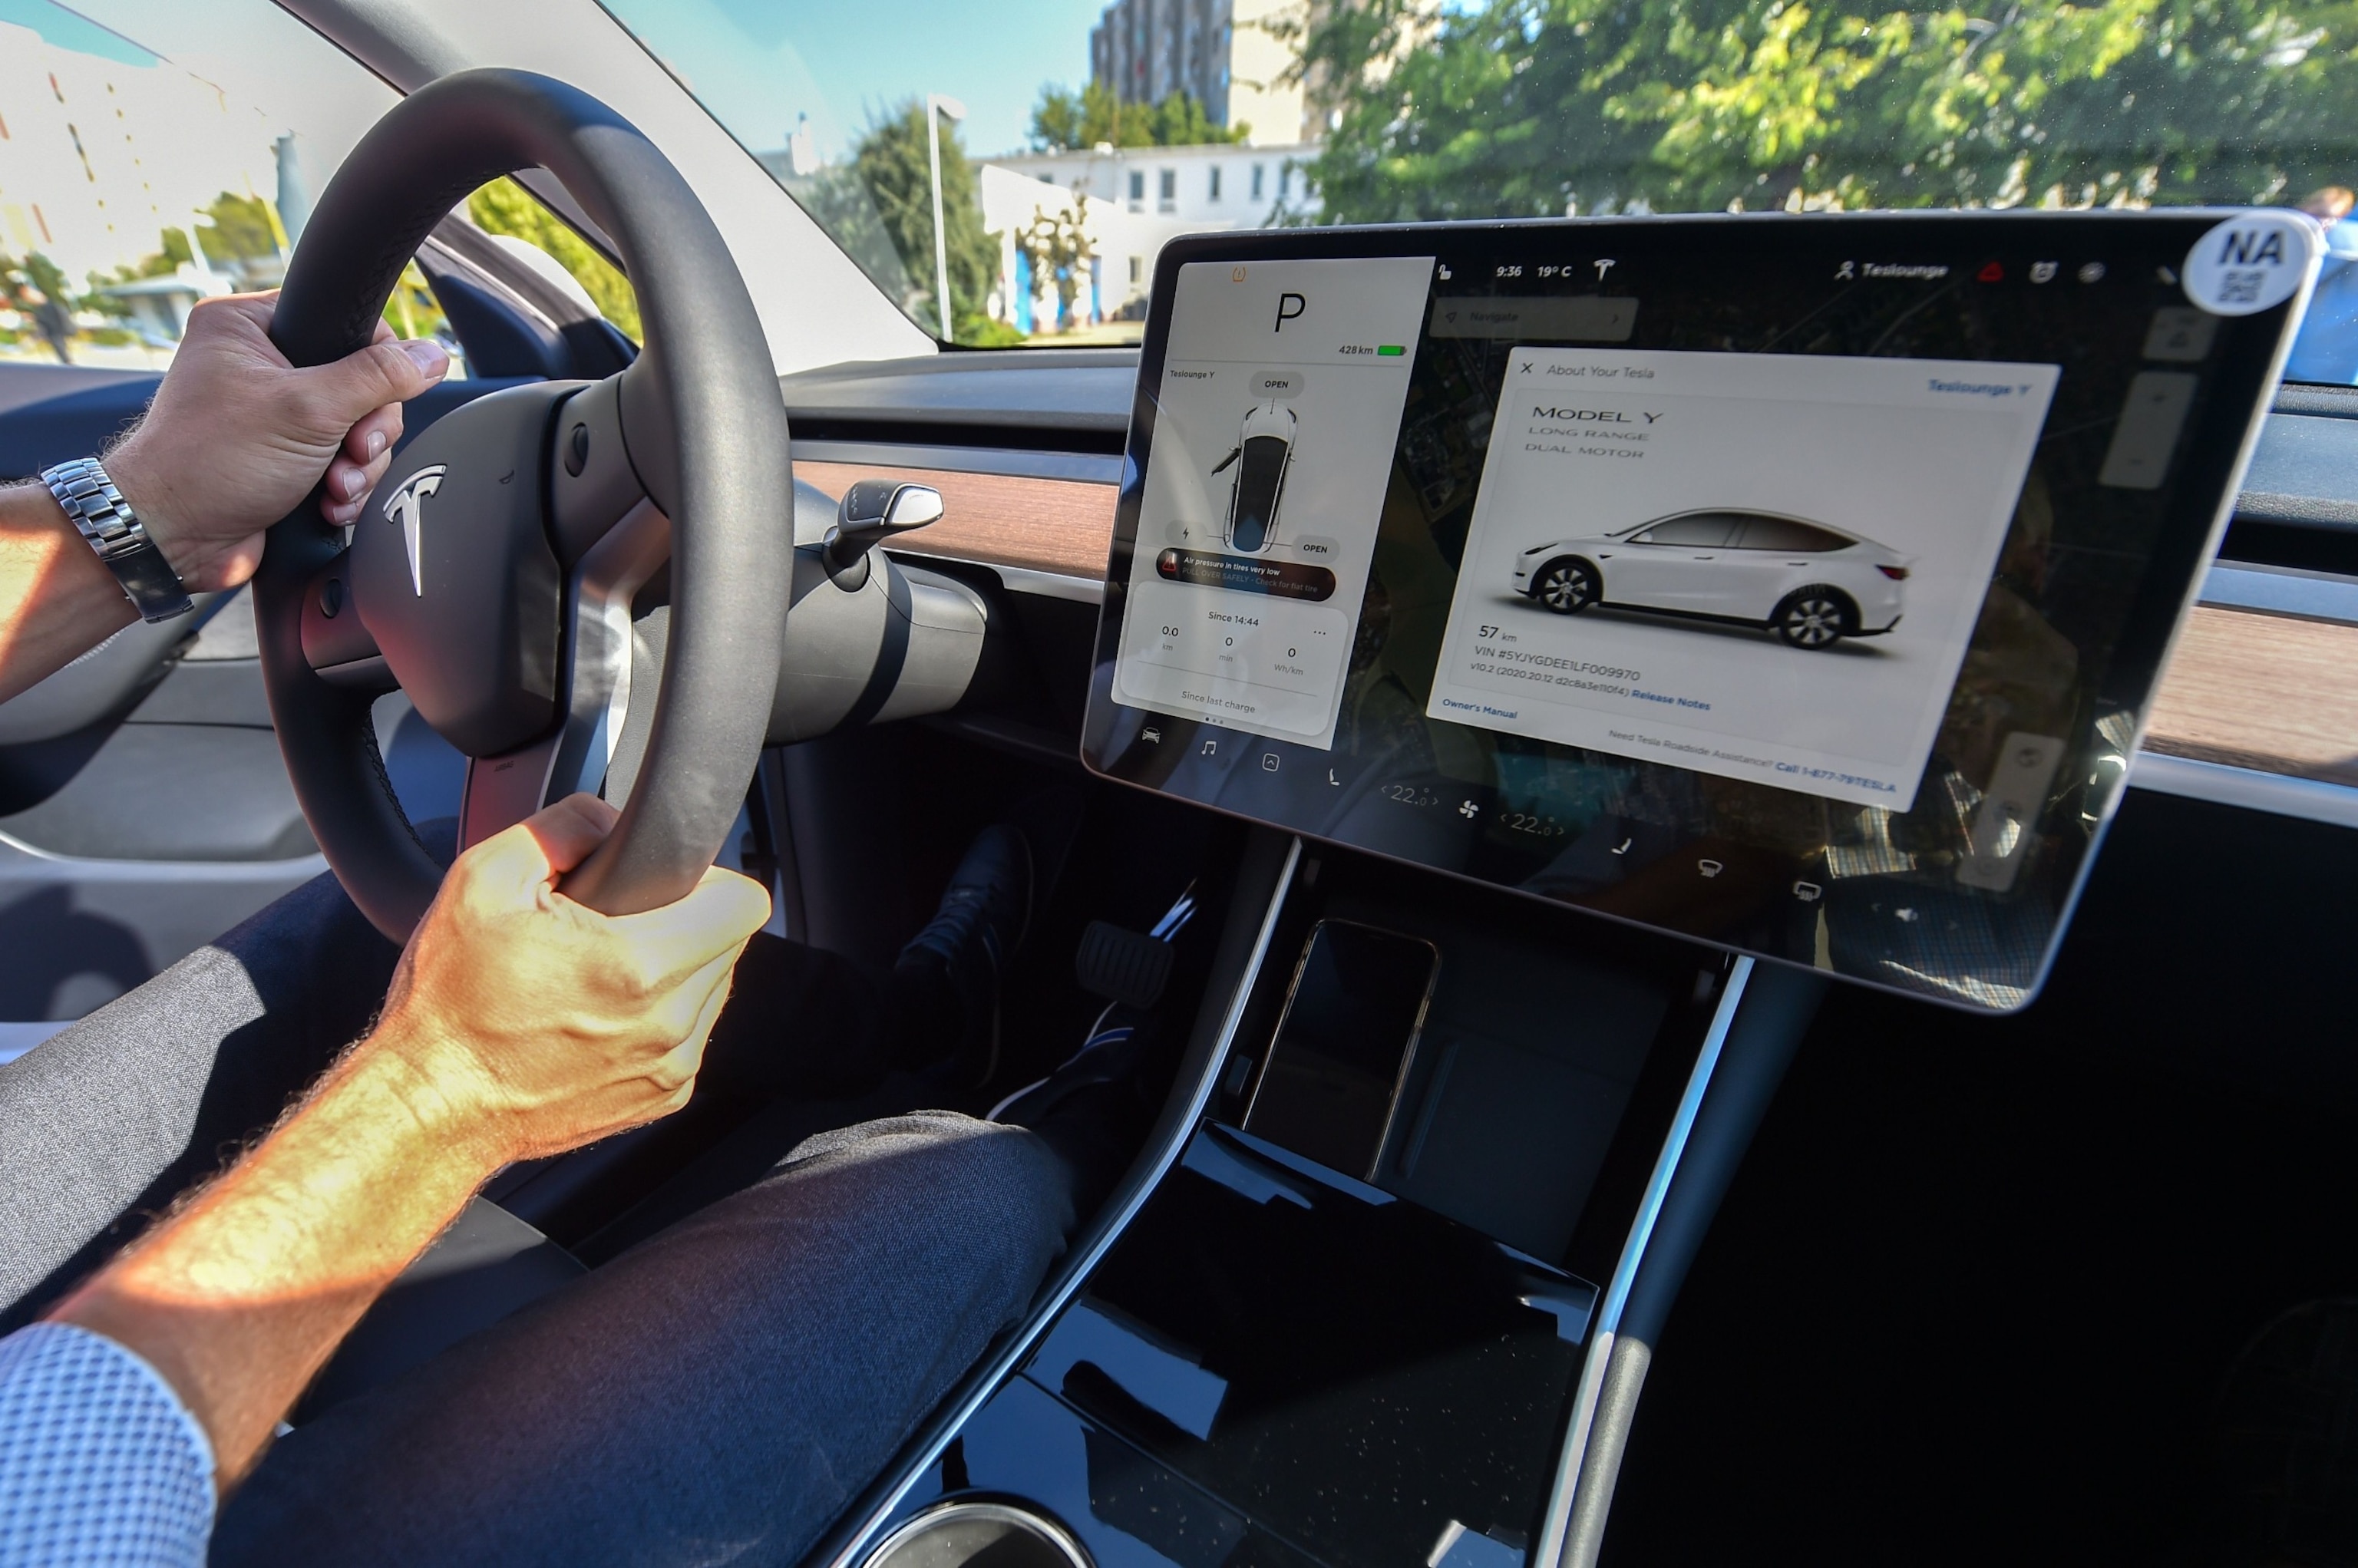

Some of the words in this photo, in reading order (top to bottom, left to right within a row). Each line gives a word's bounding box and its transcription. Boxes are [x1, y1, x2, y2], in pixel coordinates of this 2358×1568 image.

[2219, 230, 2284, 264] NA
[1497, 266, 1522, 277] 9:36
[1861, 262, 1949, 280] Teslounge
[1274, 292, 1306, 332] P
[1470, 312, 1519, 323] Navigate
[1339, 345, 1357, 355] 428
[1359, 345, 1373, 355] km
[1170, 370, 1207, 380] Teslounge
[1547, 365, 1585, 376] About
[1590, 366, 1619, 377] Your
[1624, 367, 1655, 378] Tesla
[1533, 407, 1632, 423] MODEL
[1643, 412, 1664, 424] Y
[1528, 427, 1578, 437] LONG
[1584, 430, 1650, 441] RANGE
[1525, 443, 1572, 454] DUAL
[1578, 446, 1644, 458] MOTOR
[1303, 543, 1328, 554] OPEN
[1195, 559, 1224, 569] pressure
[1225, 561, 1232, 569] in
[1233, 563, 1249, 572] tires
[1250, 566, 1266, 575] very
[1267, 567, 1280, 576] low
[1182, 566, 1200, 575] PULL
[1201, 569, 1220, 578] OVER
[1222, 573, 1249, 583] SAFELY
[1255, 577, 1277, 587] Check
[1279, 580, 1290, 589] for
[1305, 584, 1318, 593] tire
[1208, 611, 1232, 622] Since
[1234, 615, 1260, 626] 14:44
[1161, 626, 1179, 637] 0.0
[1478, 625, 1499, 639] 57
[1501, 633, 1517, 642] km
[1162, 643, 1173, 652] km
[1225, 637, 1233, 646] 0
[1219, 654, 1233, 662] min
[1287, 648, 1296, 658] 0
[1475, 645, 1495, 657] VIN
[1274, 664, 1303, 675] Wh/km
[1470, 662, 1494, 673] v10.2
[1631, 689, 1675, 705] Release
[1676, 697, 1712, 711] Notes
[1181, 691, 1204, 702] Since
[1207, 696, 1223, 706] last
[1224, 700, 1256, 714] charge
[1443, 698, 1481, 712] Owner's
[1483, 705, 1518, 719] Manual
[1609, 730, 1635, 741] Need
[1637, 734, 1661, 747] Tesla
[1663, 739, 1710, 756] Roadside
[1775, 761, 1800, 774] Call
